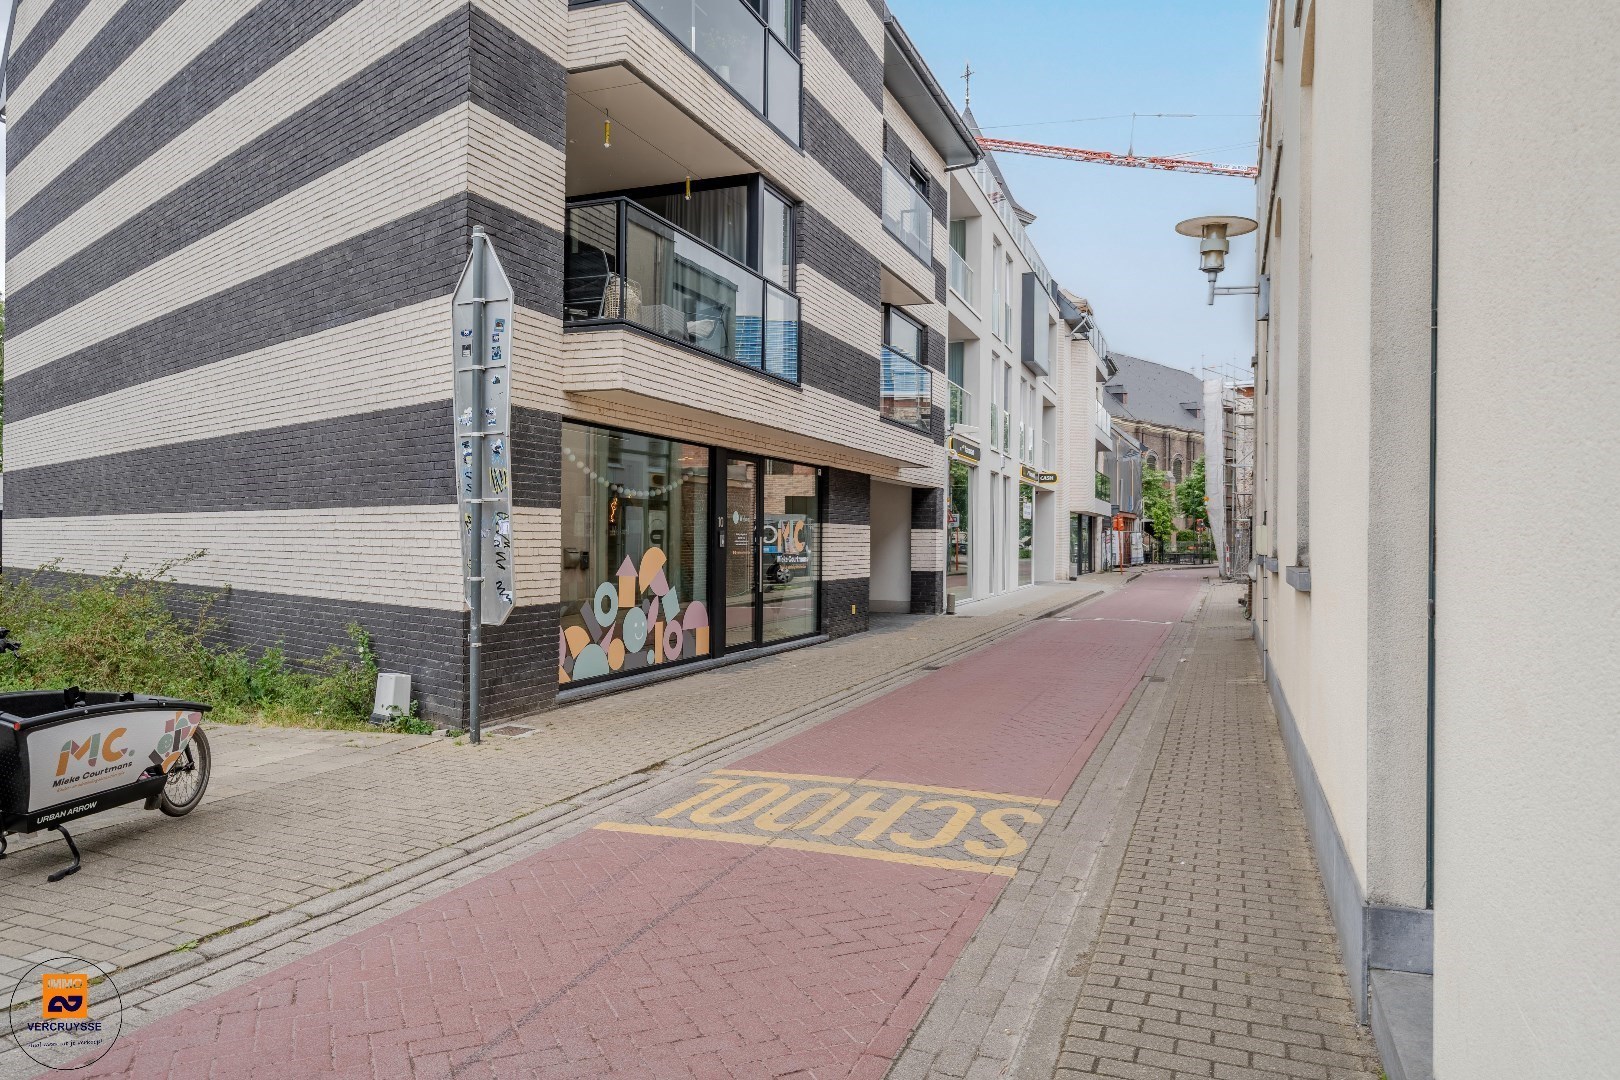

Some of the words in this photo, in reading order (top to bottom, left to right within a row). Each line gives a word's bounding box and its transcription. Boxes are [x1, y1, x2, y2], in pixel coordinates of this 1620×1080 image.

[717, 516, 724, 528] 10
[52, 775, 80, 788] Mieke
[82, 761, 133, 780] Courtmans
[36, 810, 67, 824] URBAN
[67, 801, 98, 816] ARROW
[655, 777, 1043, 858] SCHOOL
